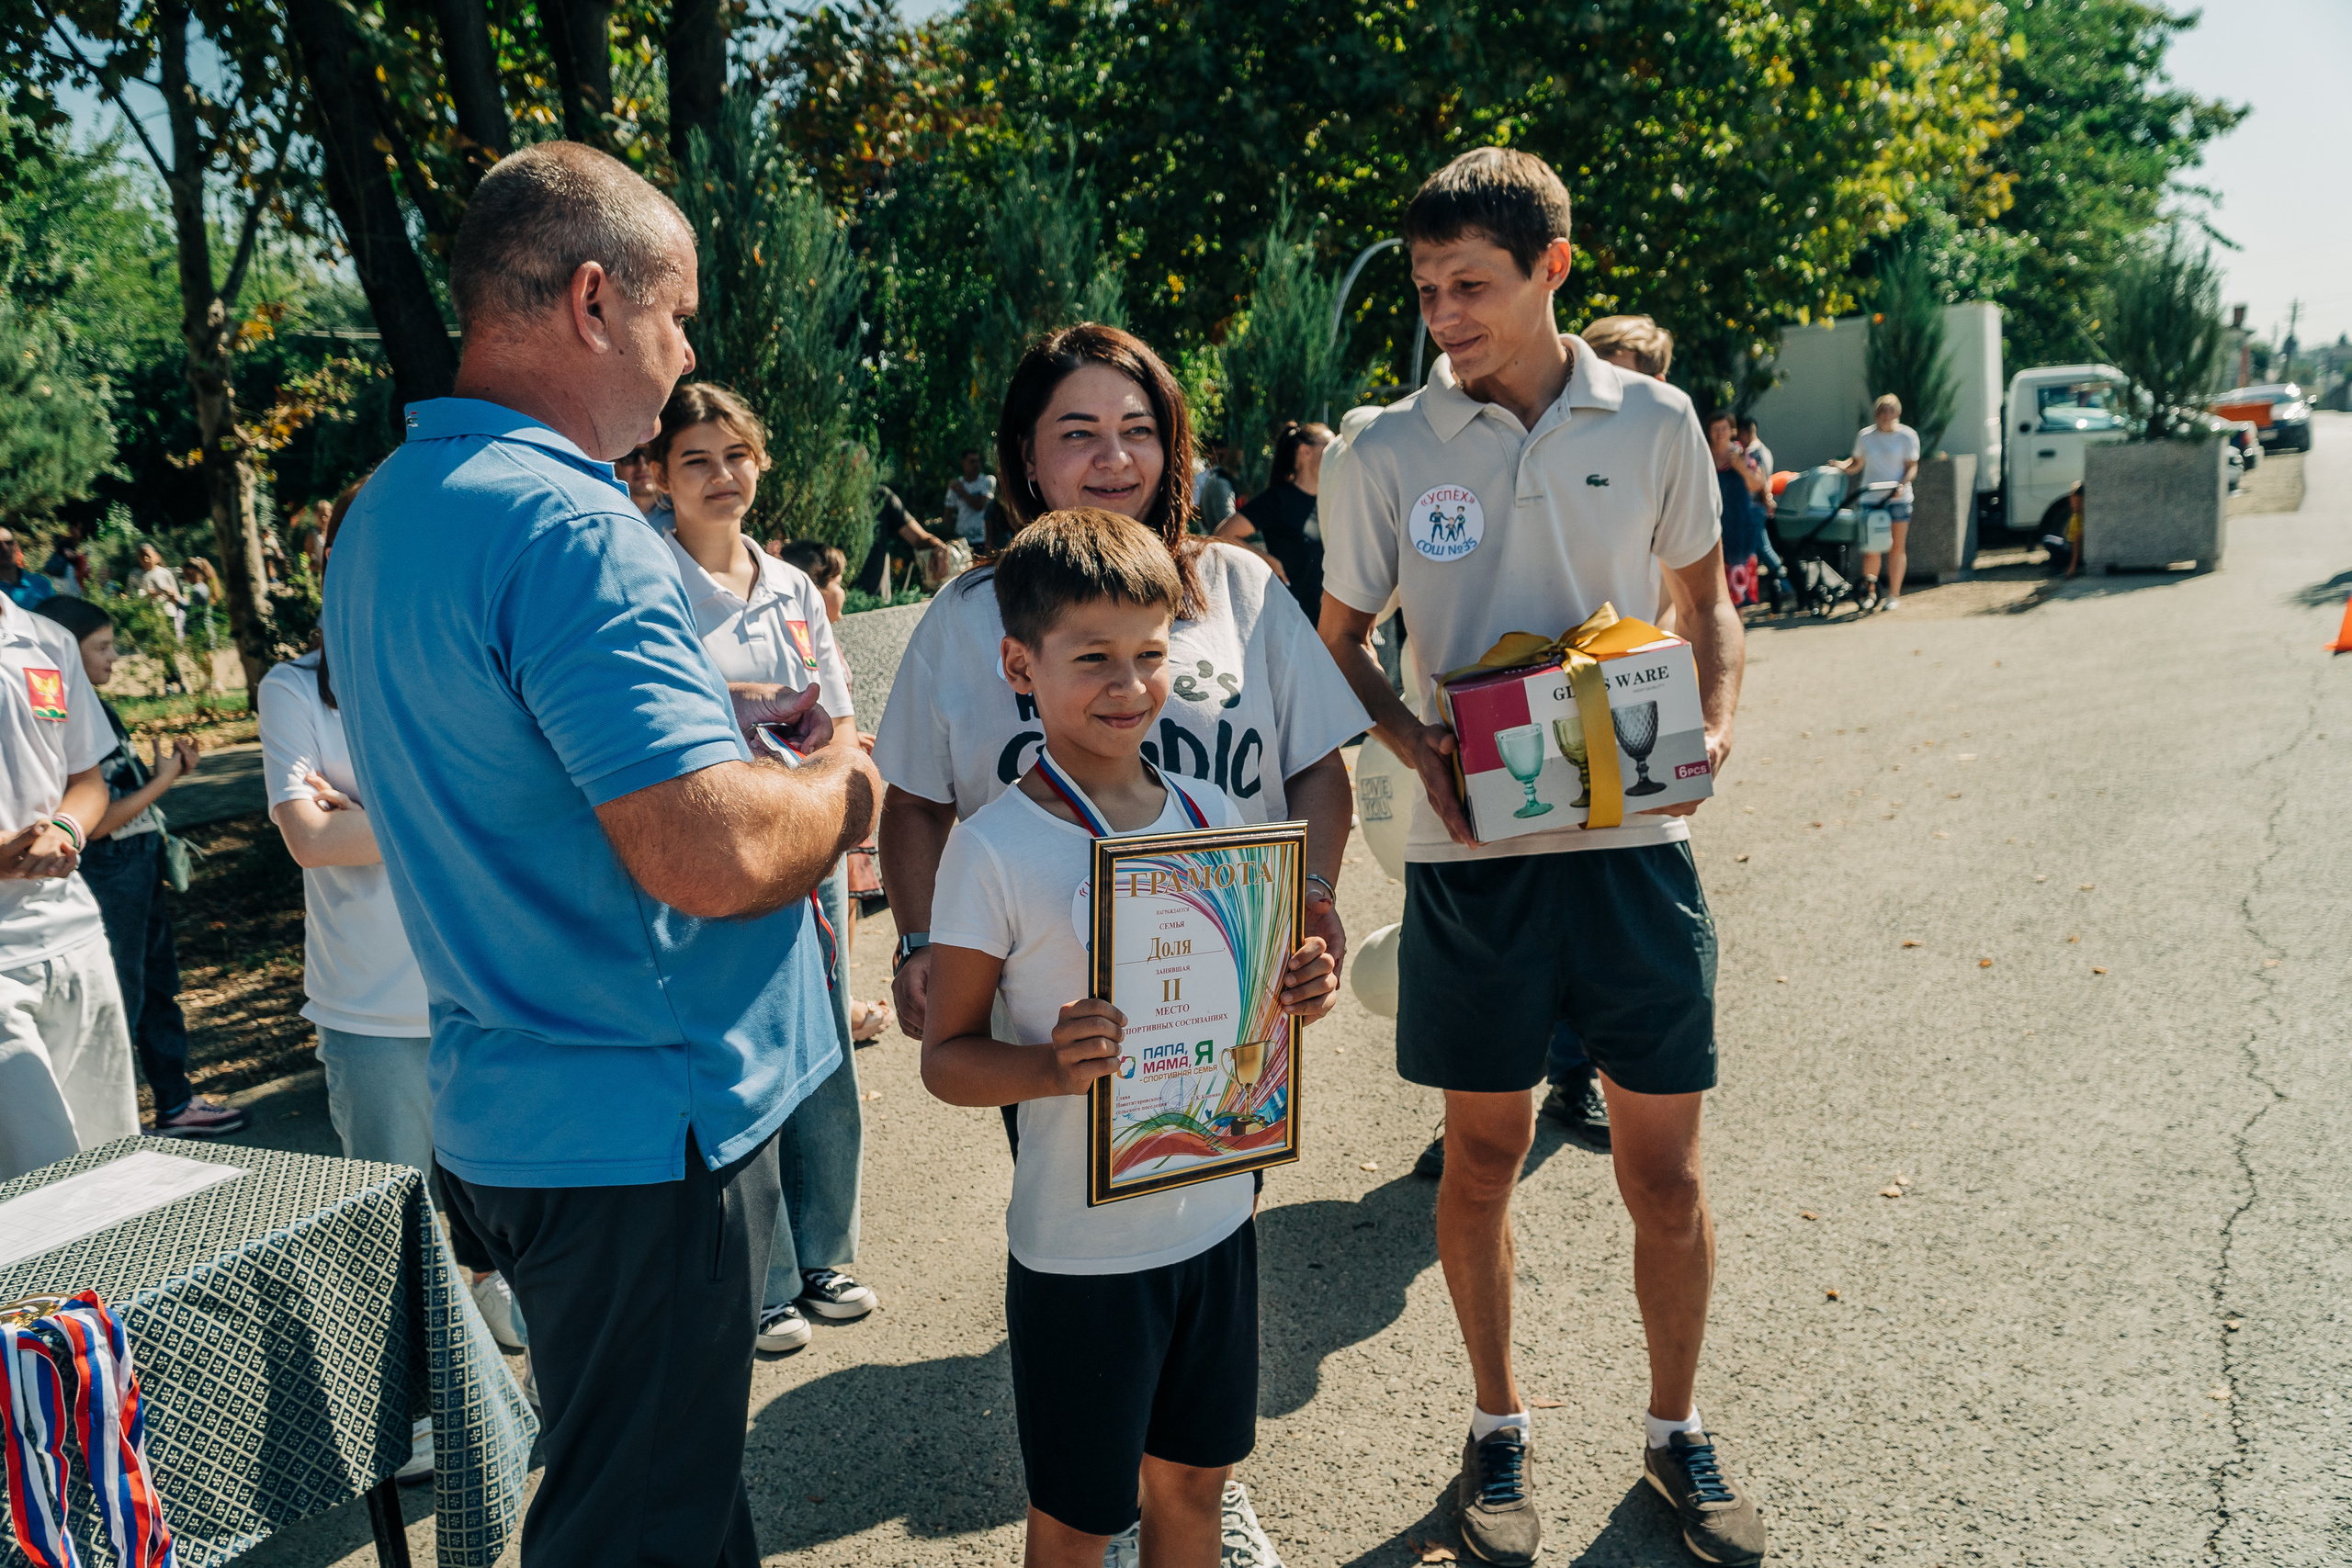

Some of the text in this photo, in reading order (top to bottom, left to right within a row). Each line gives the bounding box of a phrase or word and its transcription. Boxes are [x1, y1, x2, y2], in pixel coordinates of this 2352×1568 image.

[1416, 536, 1477, 556] СОШ №35
[1615, 665, 1669, 688] WARE
[1679, 765, 1707, 778] 6PCS
[1129, 860, 1274, 897] ГРАМОТА
[1156, 907, 1190, 916] НАГРАЖДАЕТСЯ
[1159, 920, 1185, 931] СЕМЬЯ
[1147, 936, 1192, 964] Доля
[1156, 964, 1191, 976] ЗАНЯВШАЯ
[1161, 977, 1182, 1003] II
[1155, 1003, 1191, 1017] МЕСТО
[1175, 1012, 1228, 1028] СОСТЯЗАНИЯХ
[1143, 1039, 1214, 1066] ПАПА, Я
[1143, 1055, 1192, 1075] МАМА,
[1193, 1064, 1218, 1076] СЕМЬЯ
